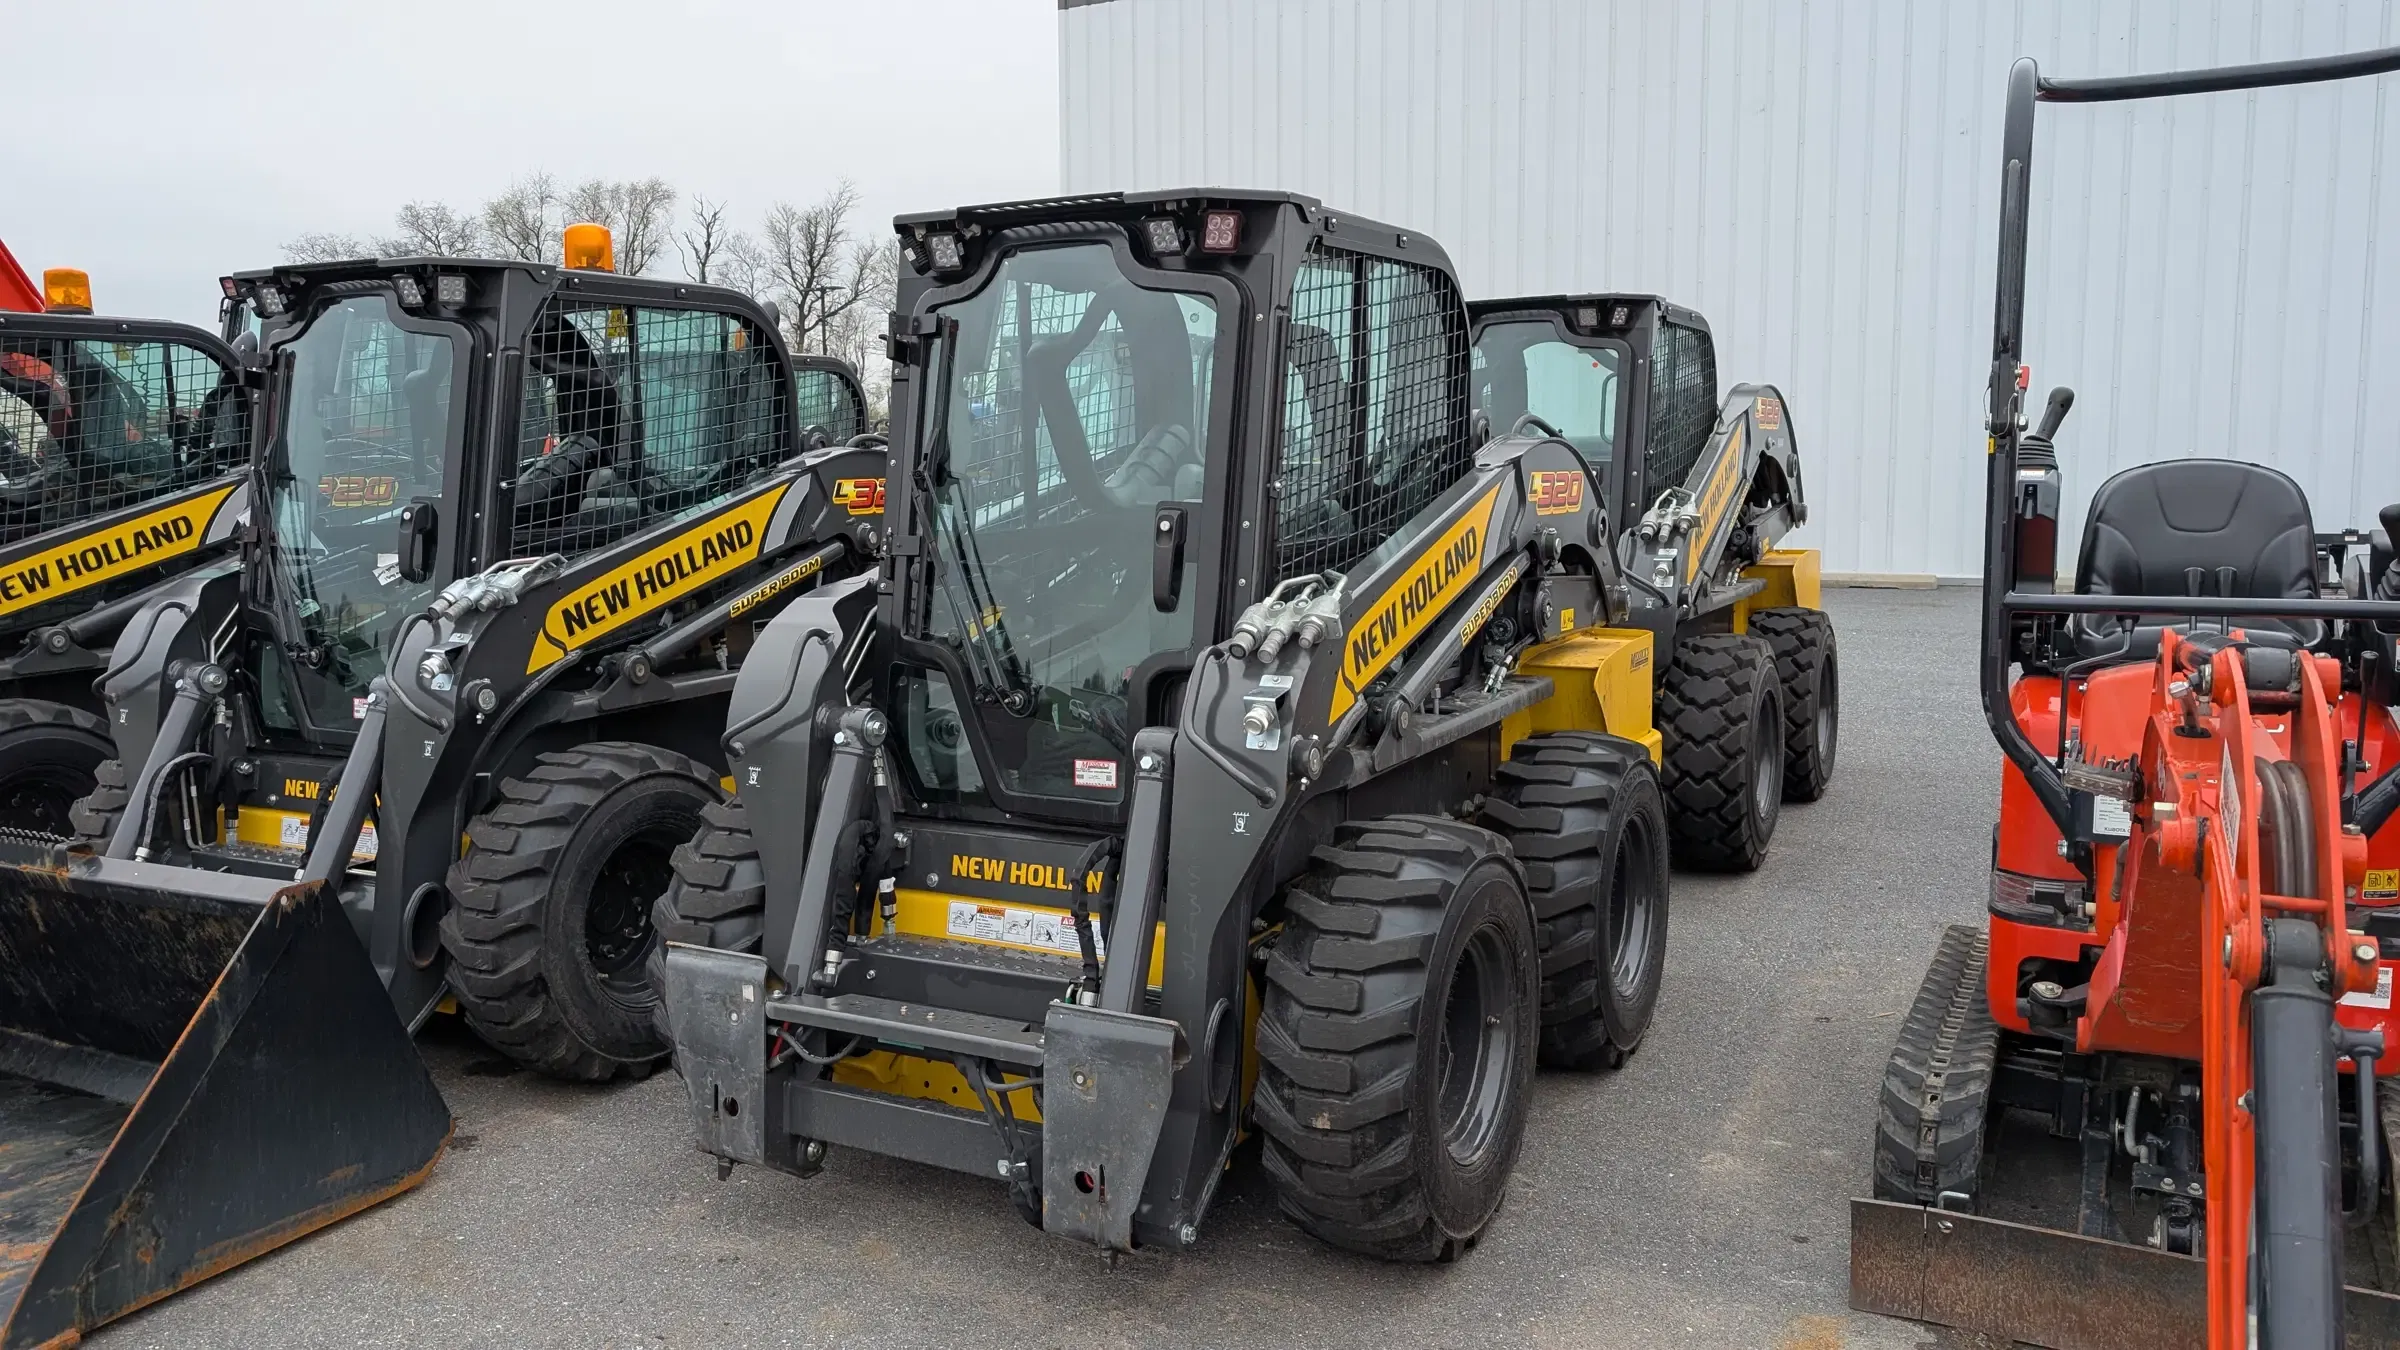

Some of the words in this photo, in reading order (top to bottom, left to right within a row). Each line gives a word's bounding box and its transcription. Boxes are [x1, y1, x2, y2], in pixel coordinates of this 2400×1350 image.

[1528, 471, 1584, 515] L320
[1710, 447, 1737, 517] HOLLAND
[0, 564, 51, 605] EW
[55, 515, 194, 582] HOLLAND
[561, 578, 630, 638] NEW
[634, 519, 753, 600] HOLLAND
[730, 579, 780, 618] SUPER
[780, 556, 821, 590] BOOM
[1352, 602, 1397, 677] NEW
[1401, 525, 1477, 628] HOLLAND
[1461, 597, 1492, 648] SUPER
[1490, 566, 1518, 610] BOOM
[284, 779, 320, 799] NEW
[952, 854, 1005, 882] NEW
[1009, 861, 1120, 894] HOLLN
